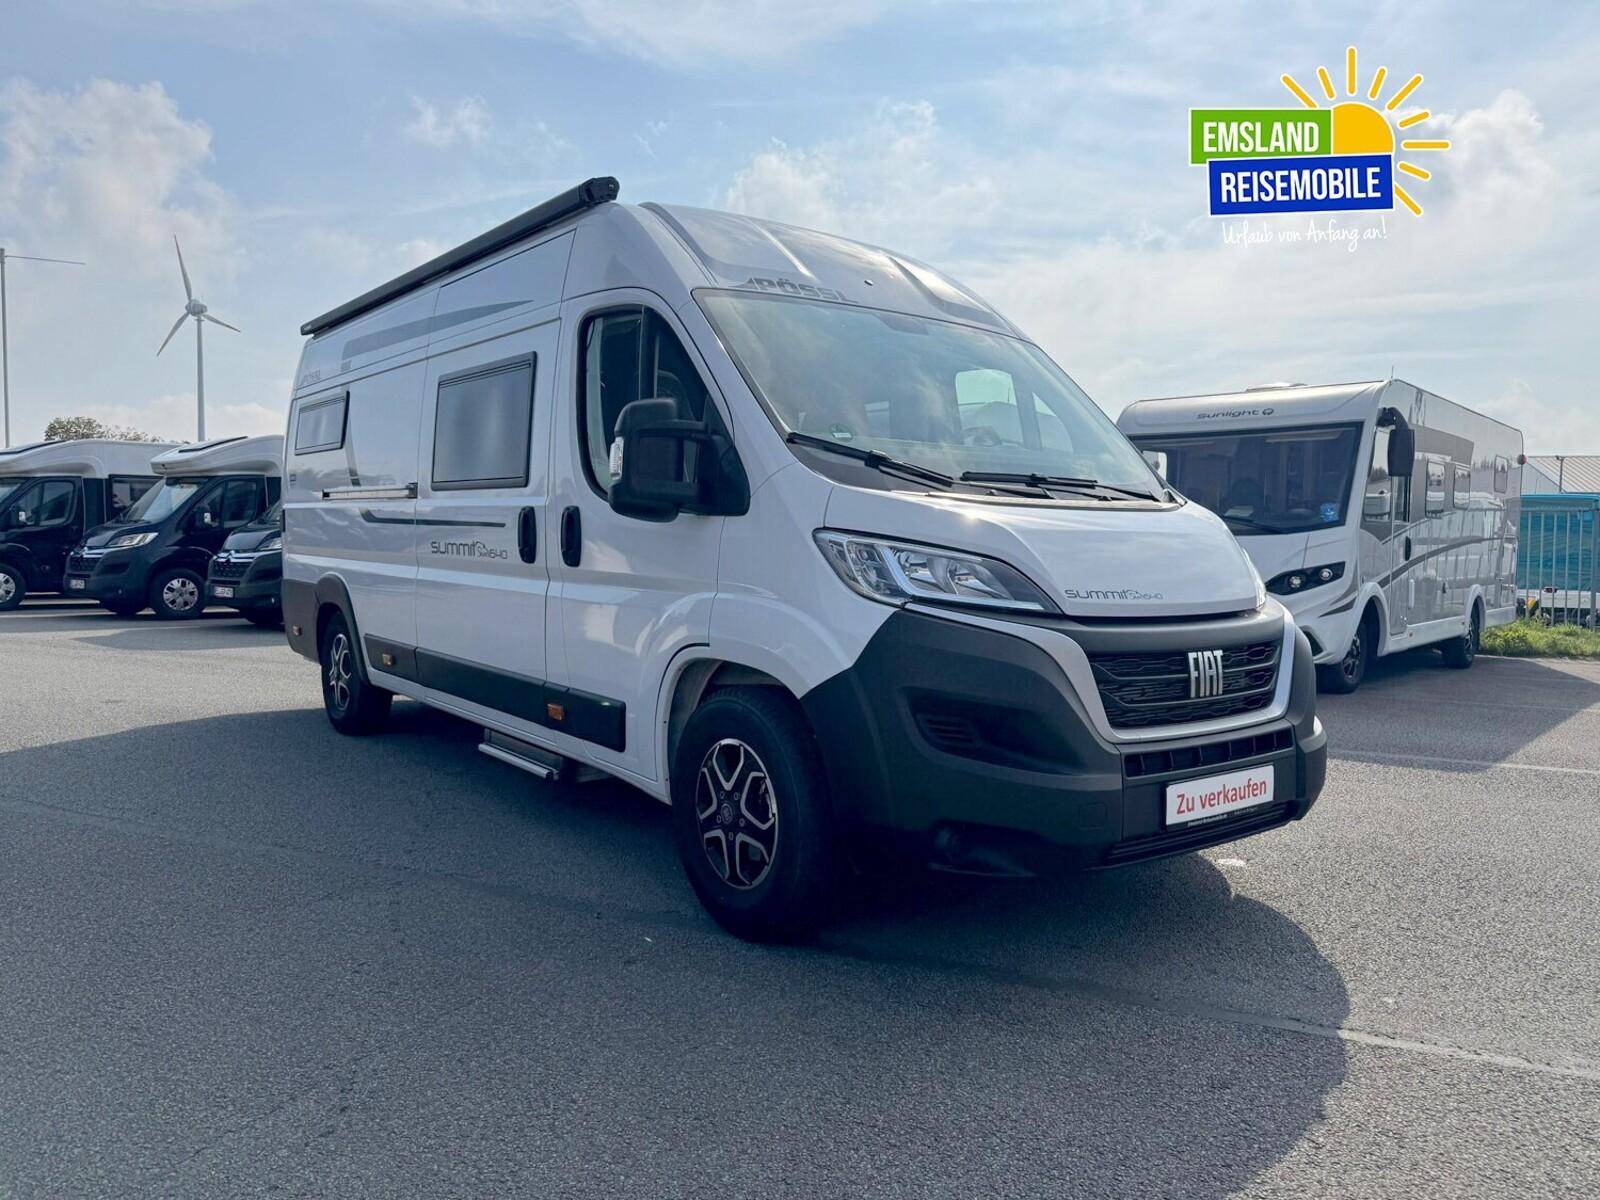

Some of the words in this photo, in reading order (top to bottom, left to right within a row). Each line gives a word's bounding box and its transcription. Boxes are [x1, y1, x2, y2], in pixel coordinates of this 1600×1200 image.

[1187, 649, 1223, 699] FIAT
[1176, 793, 1196, 815] Zu
[1199, 777, 1267, 810] verkaufen
